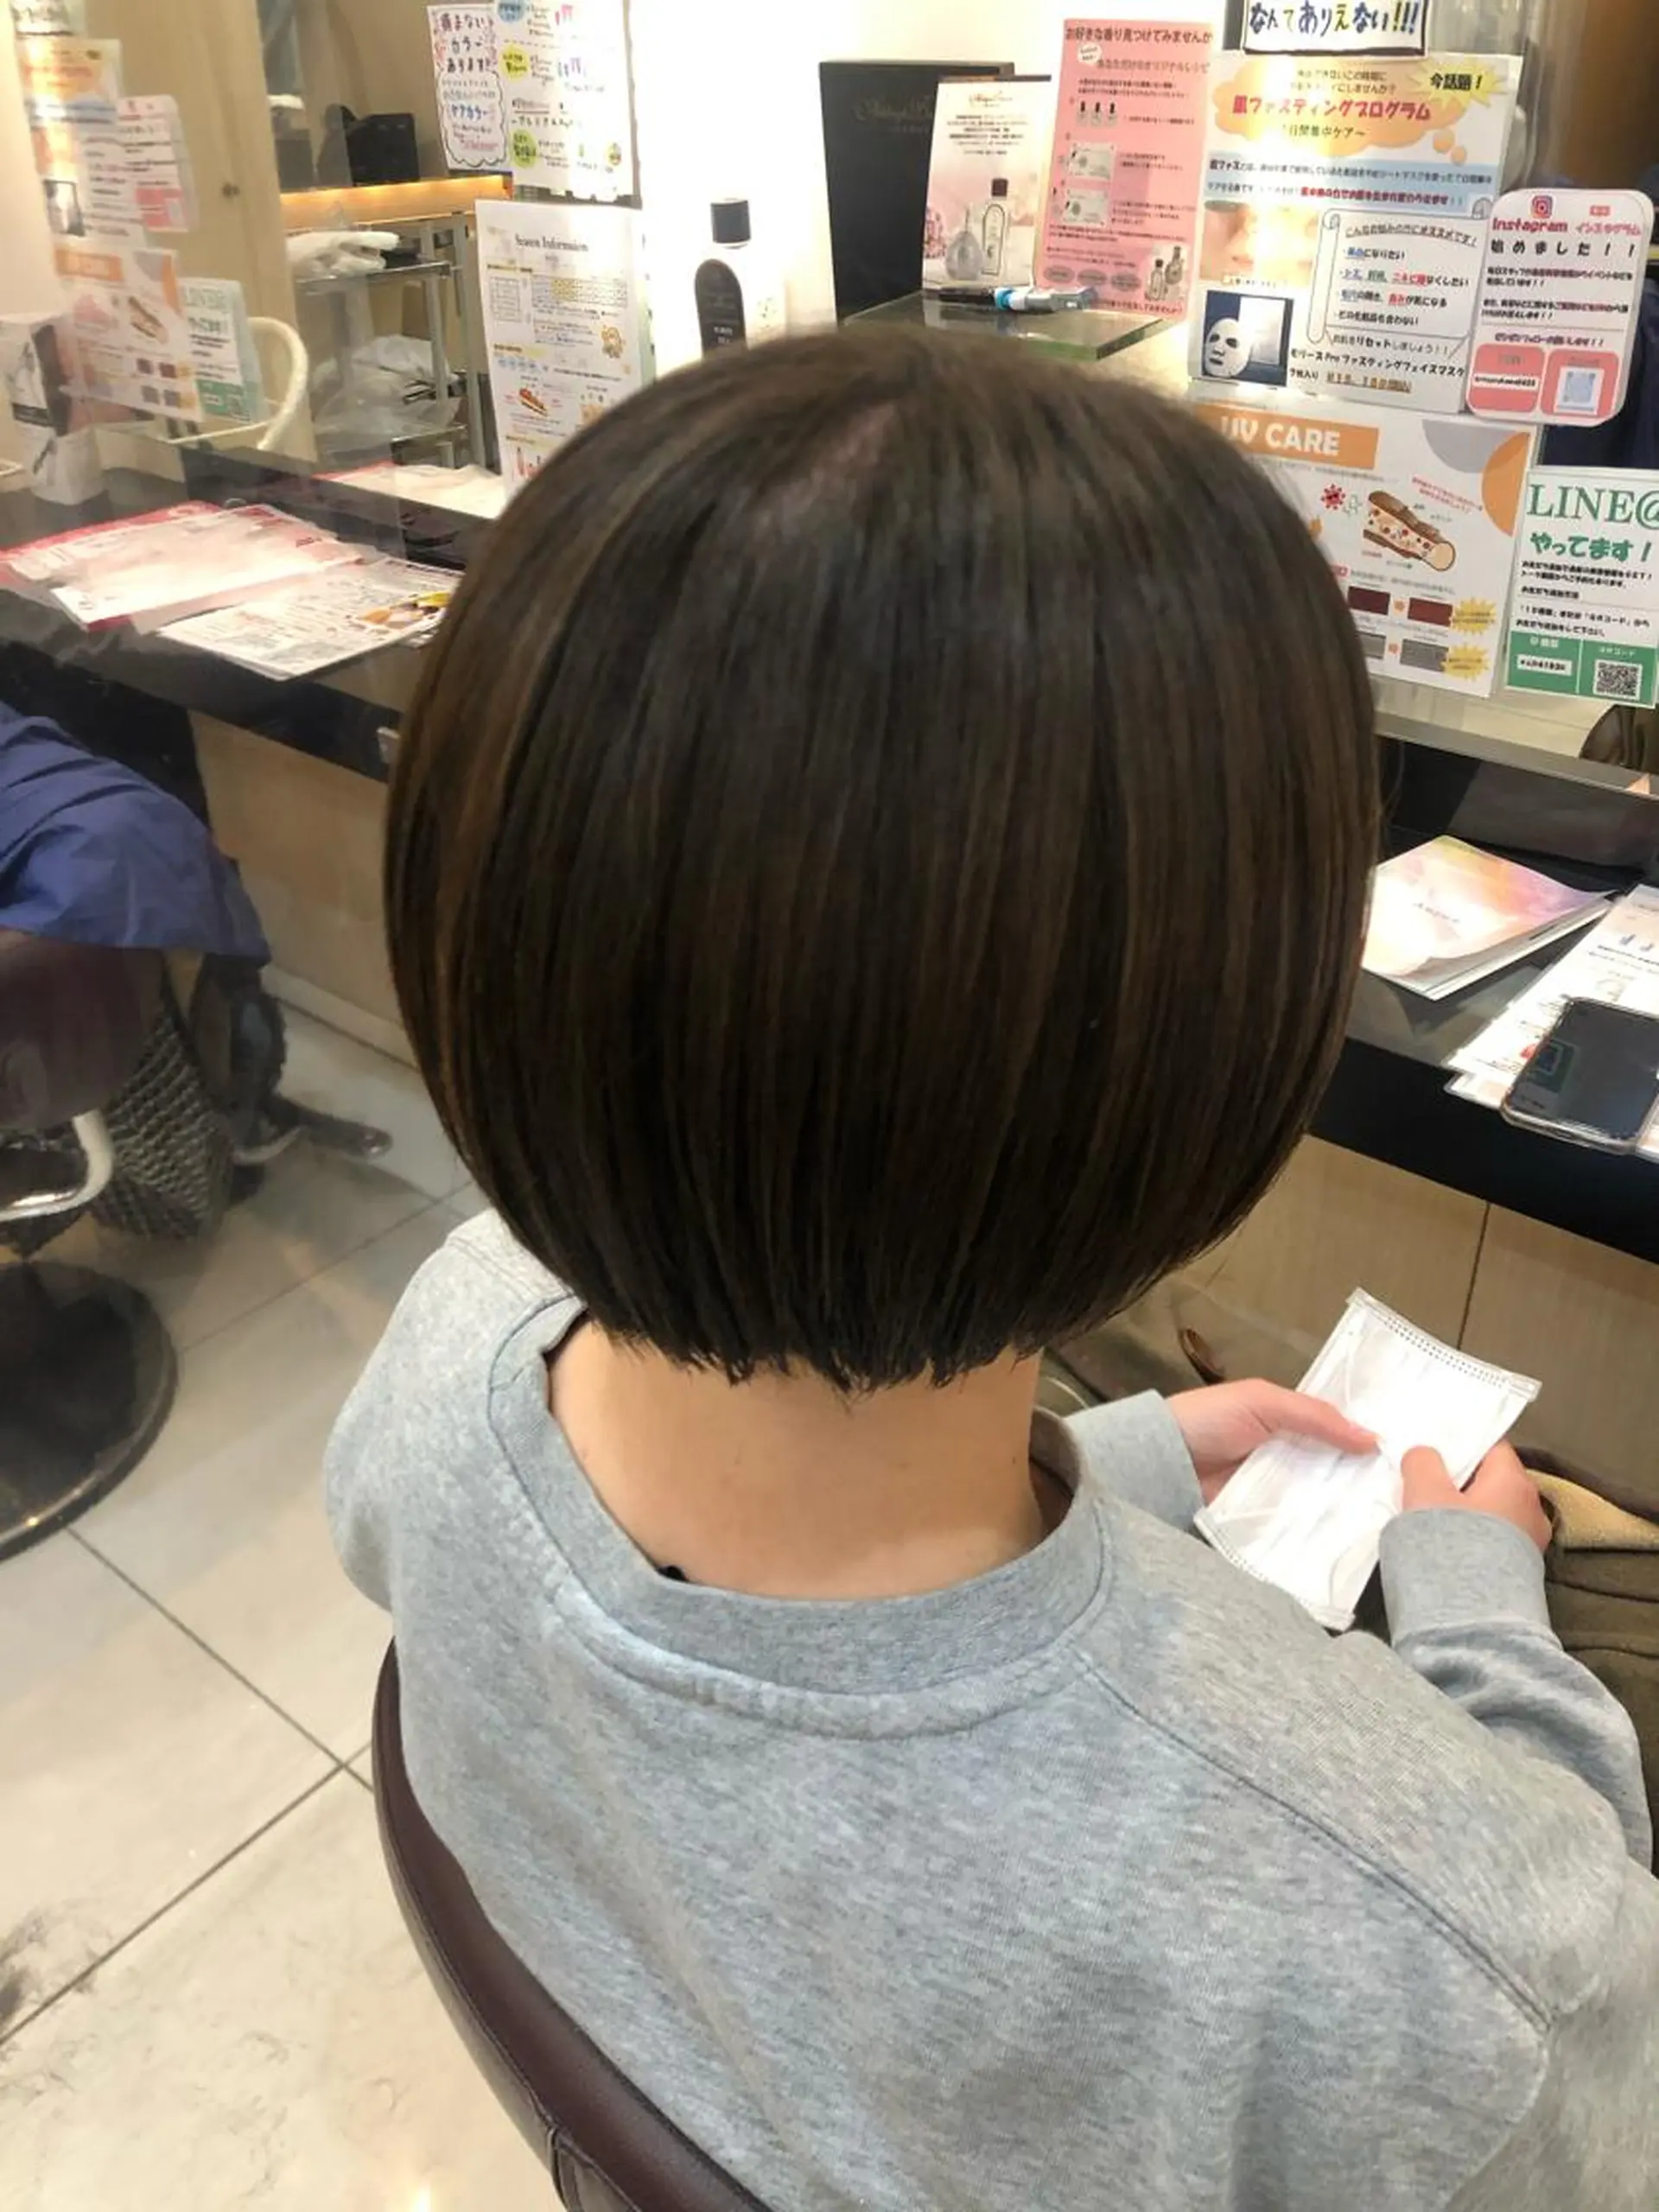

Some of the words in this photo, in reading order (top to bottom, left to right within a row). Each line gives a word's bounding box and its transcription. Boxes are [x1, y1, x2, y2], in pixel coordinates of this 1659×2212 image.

[1491, 218, 1568, 232] Instagram
[1574, 222, 1641, 236] インスタグラム
[1264, 423, 1341, 457] CARE
[1530, 531, 1652, 563] やってます！
